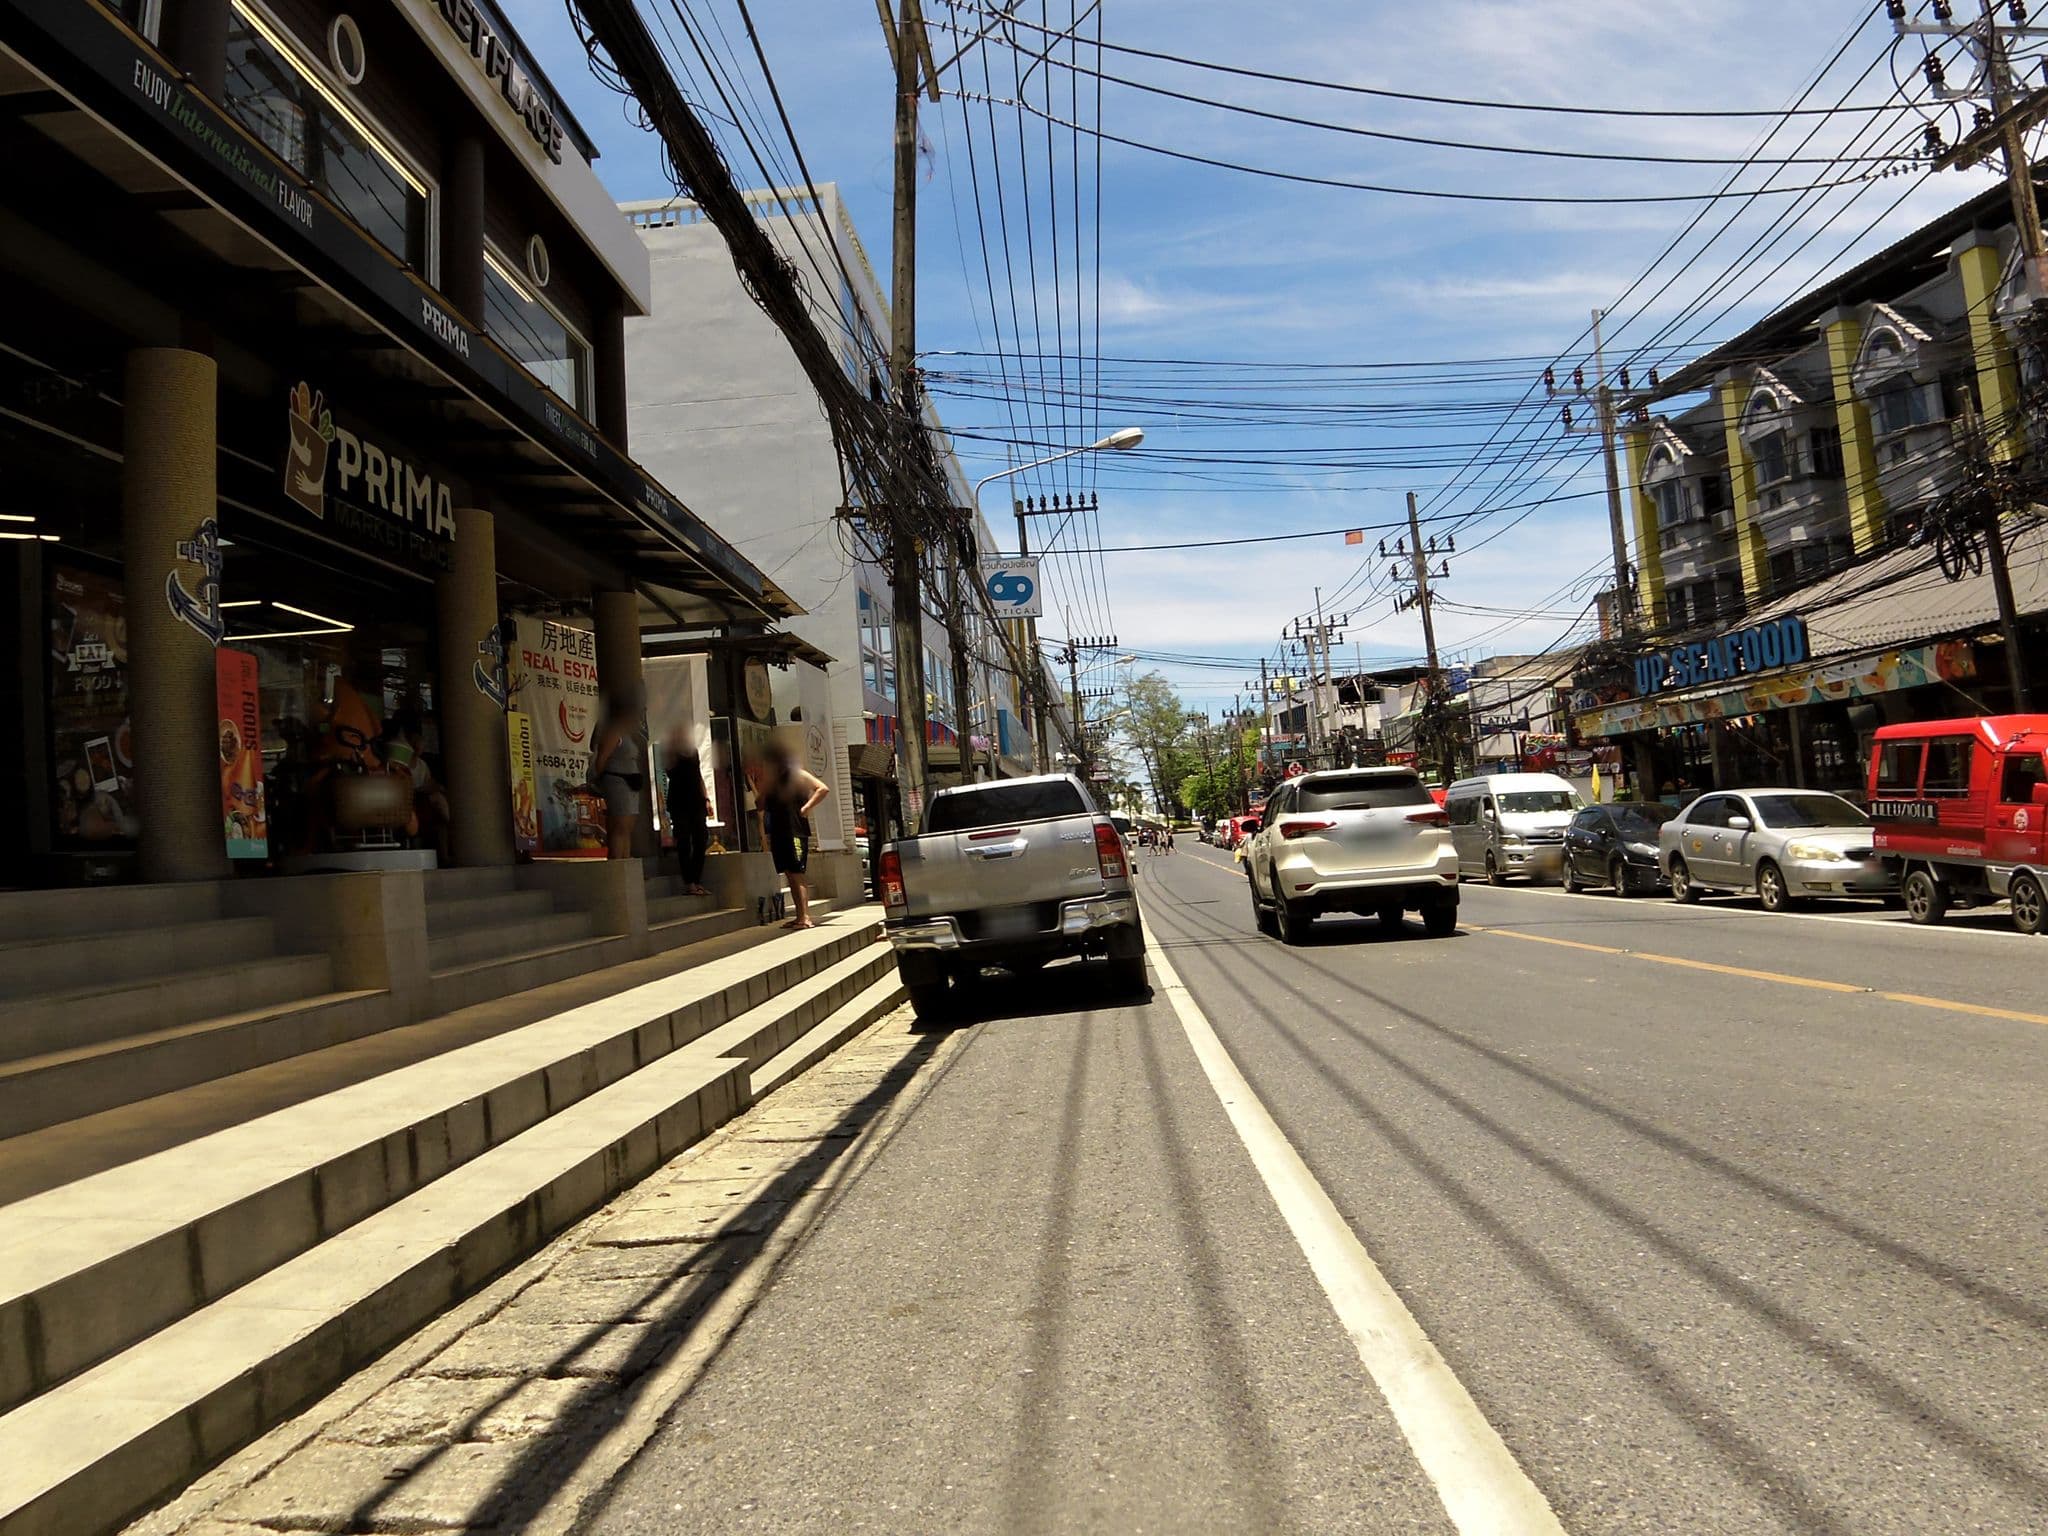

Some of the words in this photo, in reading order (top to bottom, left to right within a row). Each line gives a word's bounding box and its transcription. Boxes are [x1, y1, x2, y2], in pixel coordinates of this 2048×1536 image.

[133, 59, 171, 110] ENJOY
[170, 94, 278, 193] International
[277, 180, 313, 228] FLAVOR
[422, 298, 470, 358] PRIMA
[336, 426, 457, 542] PRIMA
[996, 607, 1038, 616] PTICAL
[77, 645, 105, 660] EAT
[522, 649, 560, 674] REAL
[1635, 652, 1665, 695] UP
[1671, 614, 1807, 689] SEAFOOD
[242, 690, 259, 751] FOODS
[519, 717, 531, 769] LIQUOR
[1487, 716, 1512, 725] ATM
[568, 758, 585, 771] 247
